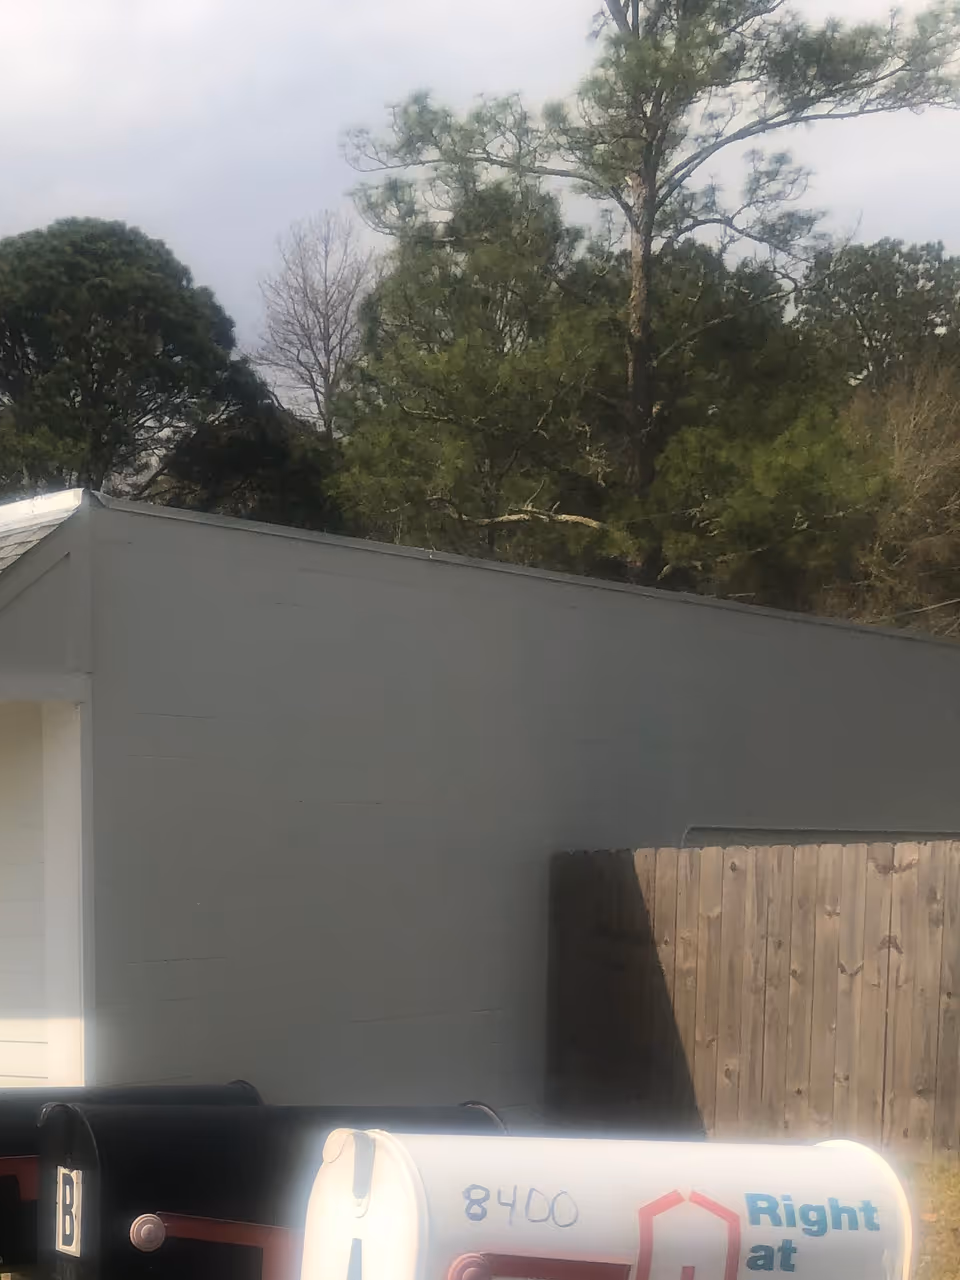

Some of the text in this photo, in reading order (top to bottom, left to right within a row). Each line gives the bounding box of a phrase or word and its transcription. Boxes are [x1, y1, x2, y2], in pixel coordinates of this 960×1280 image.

[61, 1172, 76, 1248] B
[462, 1183, 579, 1228] 8400
[744, 1192, 881, 1237] Right
[746, 1239, 798, 1272] at
